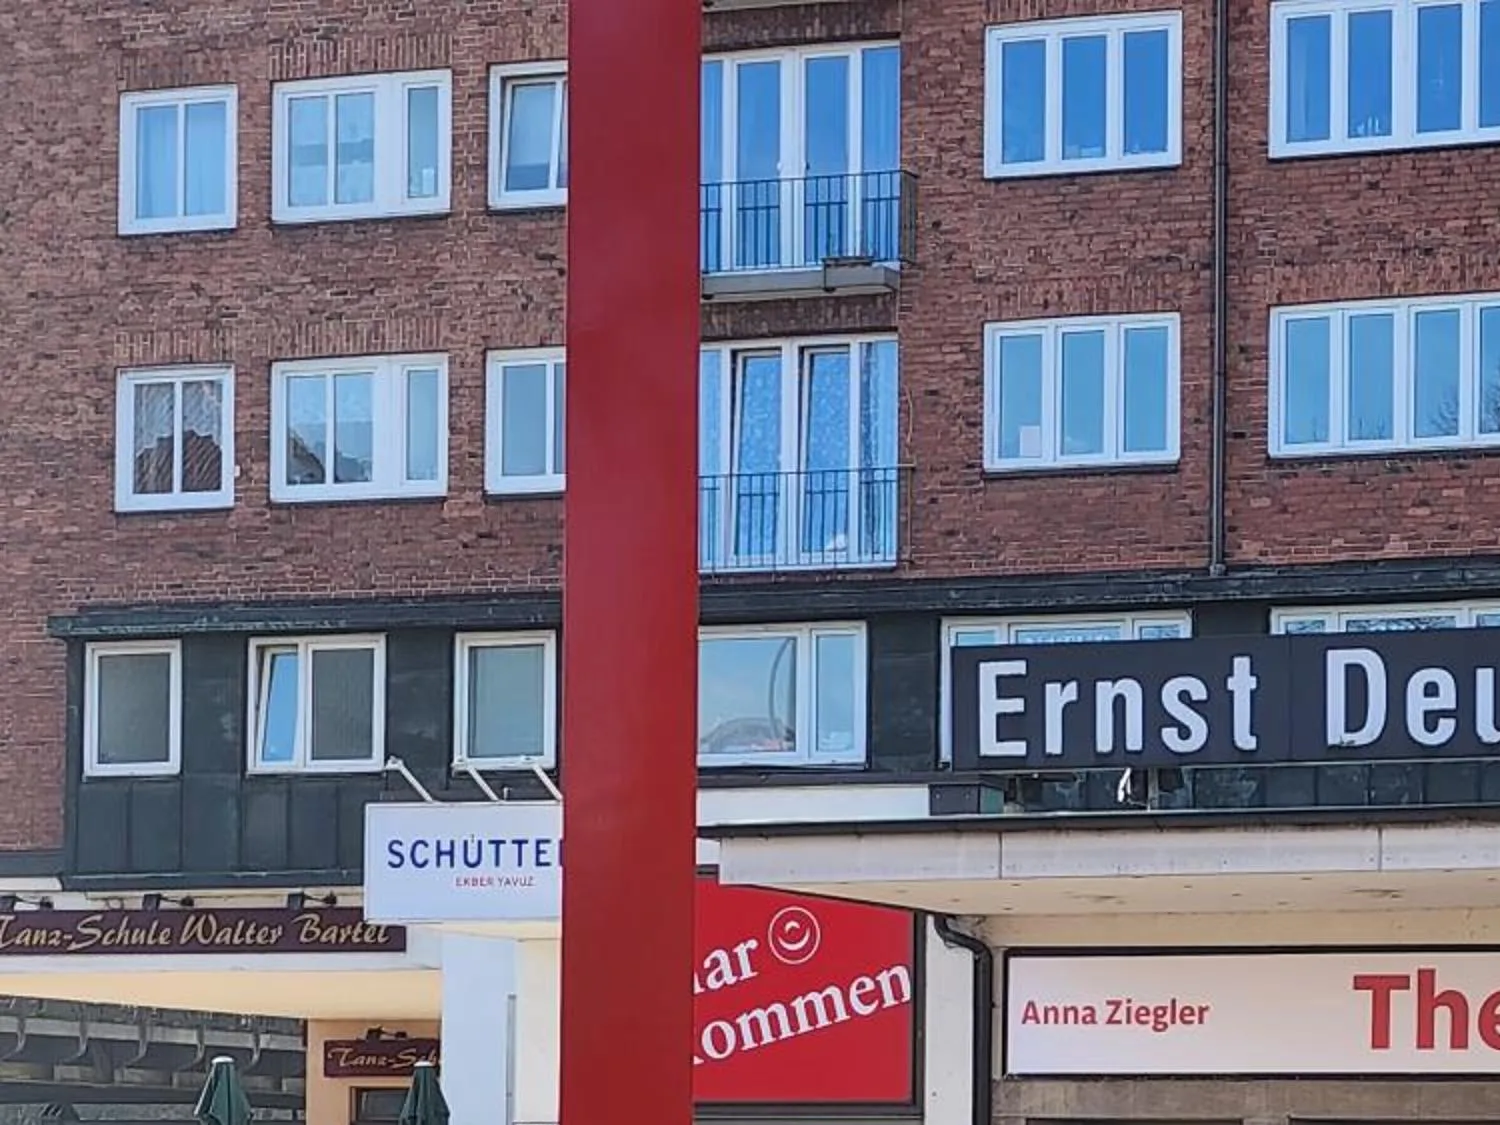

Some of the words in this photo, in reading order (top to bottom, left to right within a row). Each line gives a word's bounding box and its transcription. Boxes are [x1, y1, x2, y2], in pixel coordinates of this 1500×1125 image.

[977, 654, 1258, 758] Ernst
[455, 875, 495, 887] EKBER
[497, 875, 536, 887] YAVUZ
[179, 913, 284, 946] Walter
[291, 913, 390, 945] Bartel
[693, 938, 759, 995] ar
[693, 962, 912, 1066] ommen
[1020, 1000, 1098, 1027] Anna
[1104, 999, 1211, 1033] Ziegler
